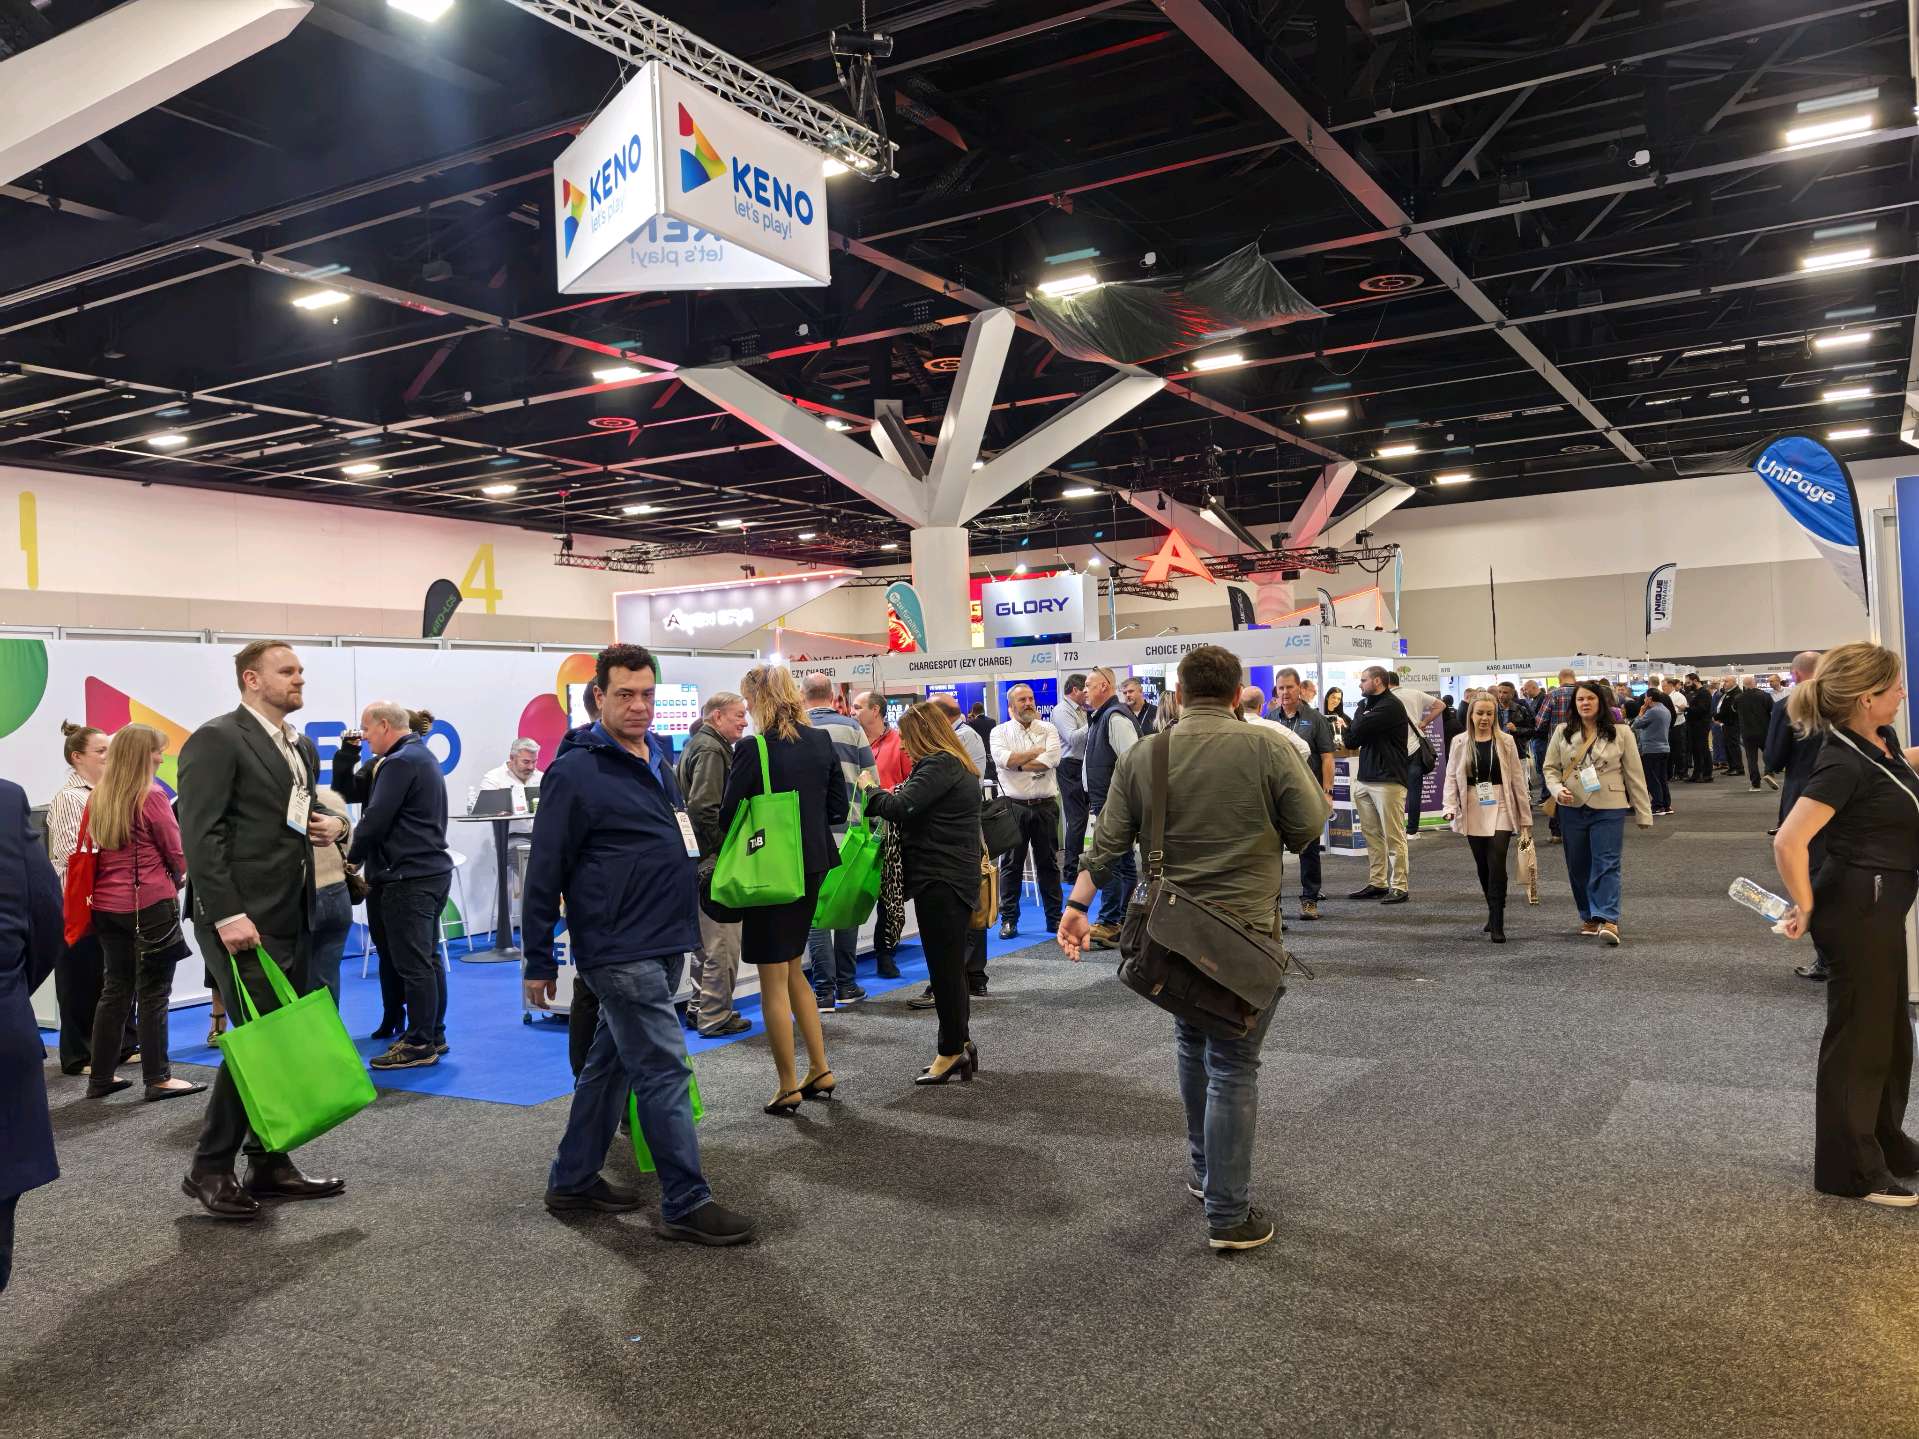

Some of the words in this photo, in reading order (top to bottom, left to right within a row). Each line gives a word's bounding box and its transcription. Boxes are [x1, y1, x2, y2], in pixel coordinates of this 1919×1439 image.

[590, 134, 641, 212] KENO
[732, 156, 814, 226] KENO
[734, 195, 760, 224] let's
[763, 213, 792, 240] play!
[1757, 456, 1836, 504] UniPage
[460, 544, 503, 615] 4
[995, 597, 1070, 616] GLORY
[1654, 580, 1665, 620] UNIQUE
[1031, 652, 1051, 664] AGE
[1064, 652, 1079, 661] 773
[1145, 644, 1178, 656] CHOICE
[1285, 634, 1310, 648] AGE
[909, 659, 957, 671] CHARGESPOT
[960, 658, 976, 669] (EZY
[978, 656, 1012, 668] CHARGE)
